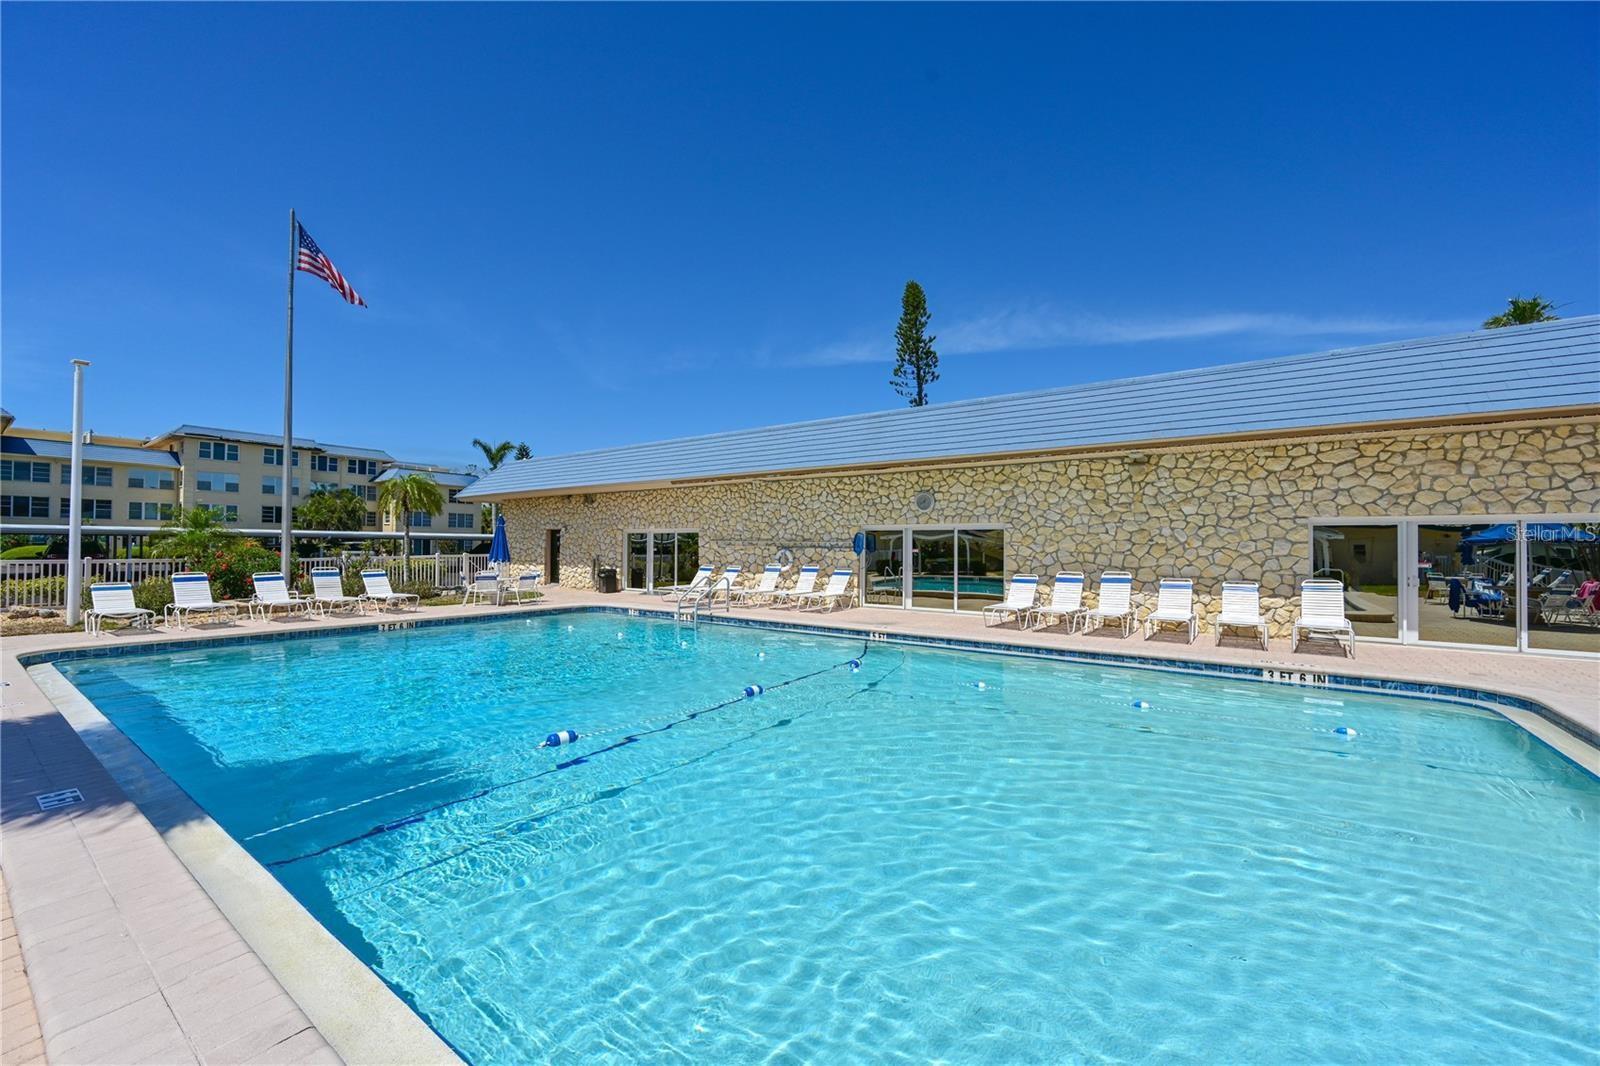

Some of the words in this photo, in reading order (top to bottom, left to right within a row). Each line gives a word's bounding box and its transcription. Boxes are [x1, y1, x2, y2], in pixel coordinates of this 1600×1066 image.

[1267, 670, 1274, 680] 3
[1279, 671, 1294, 681] FT
[1299, 673, 1307, 682] 6
[1312, 674, 1326, 683] IN
